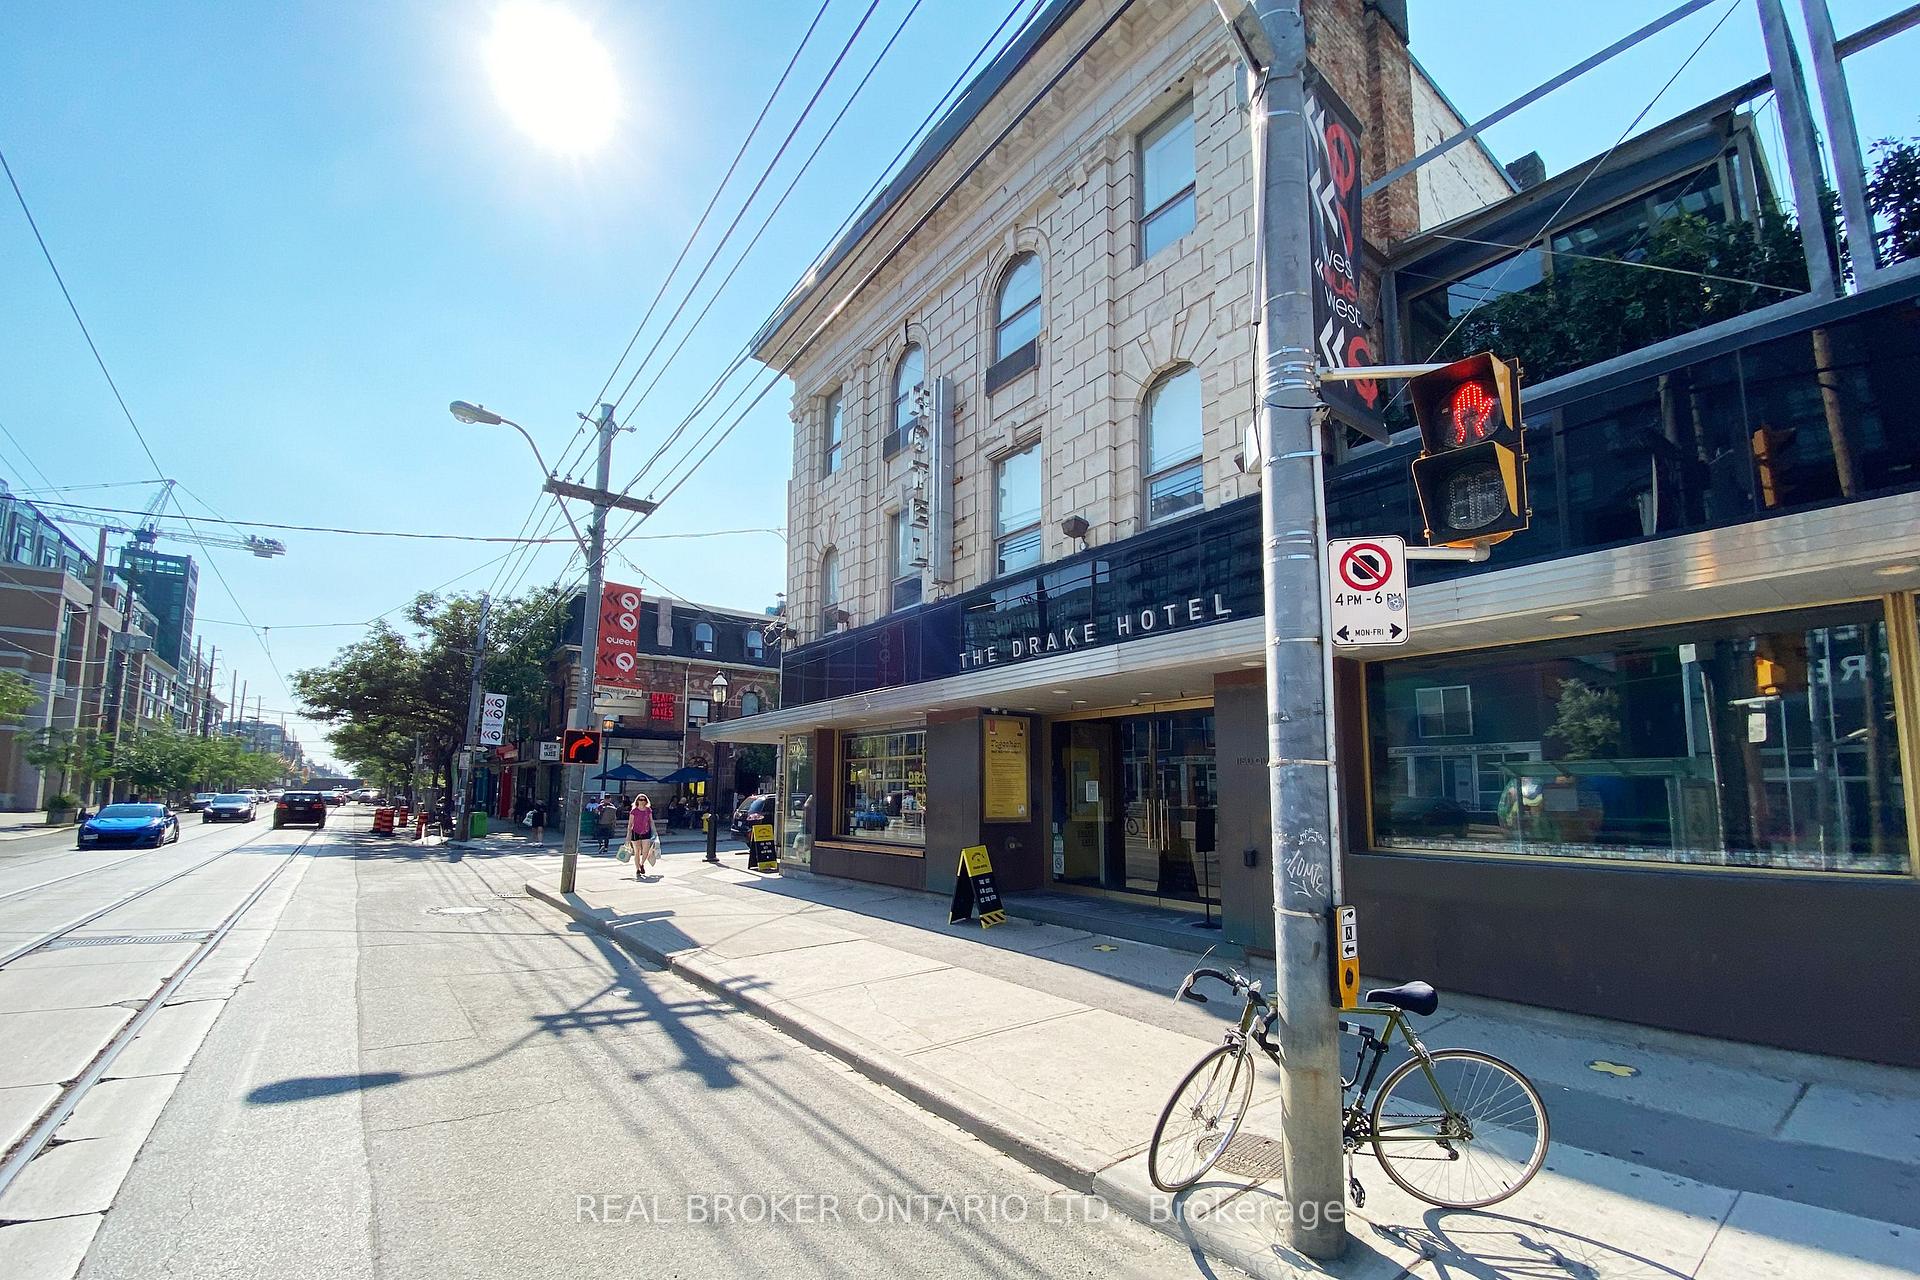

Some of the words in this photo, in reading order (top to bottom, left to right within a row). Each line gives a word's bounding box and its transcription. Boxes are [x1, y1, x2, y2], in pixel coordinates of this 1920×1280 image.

[1324, 285, 1362, 329] west
[1335, 592, 1344, 606] 4
[1346, 594, 1362, 606] PM
[1374, 591, 1383, 604] 6
[959, 645, 996, 669] THE
[1012, 622, 1097, 659] DRAKE
[1116, 592, 1232, 636] HOTEL
